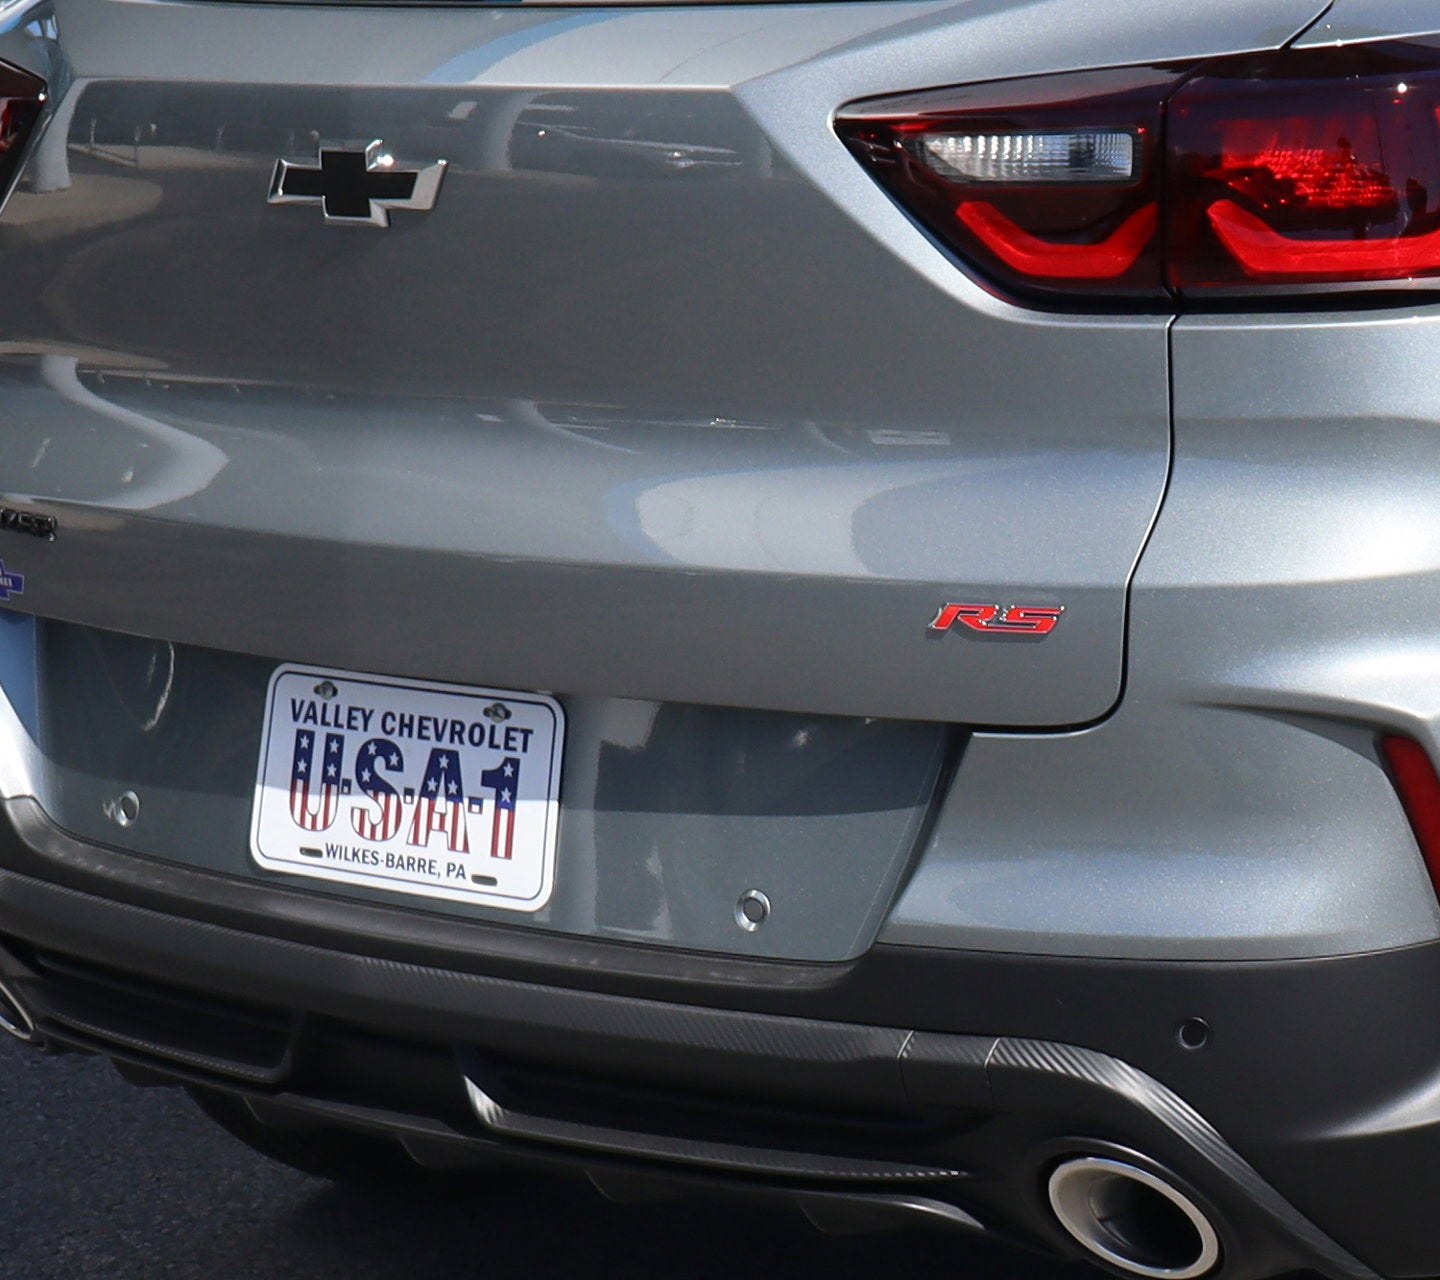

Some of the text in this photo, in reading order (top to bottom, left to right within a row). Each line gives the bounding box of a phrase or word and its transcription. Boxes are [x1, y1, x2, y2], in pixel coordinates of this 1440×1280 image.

[928, 602, 1066, 634] RS
[290, 697, 535, 754] VALLEY CHEVROLET
[325, 842, 467, 880] WILKES-BARRE, PA
